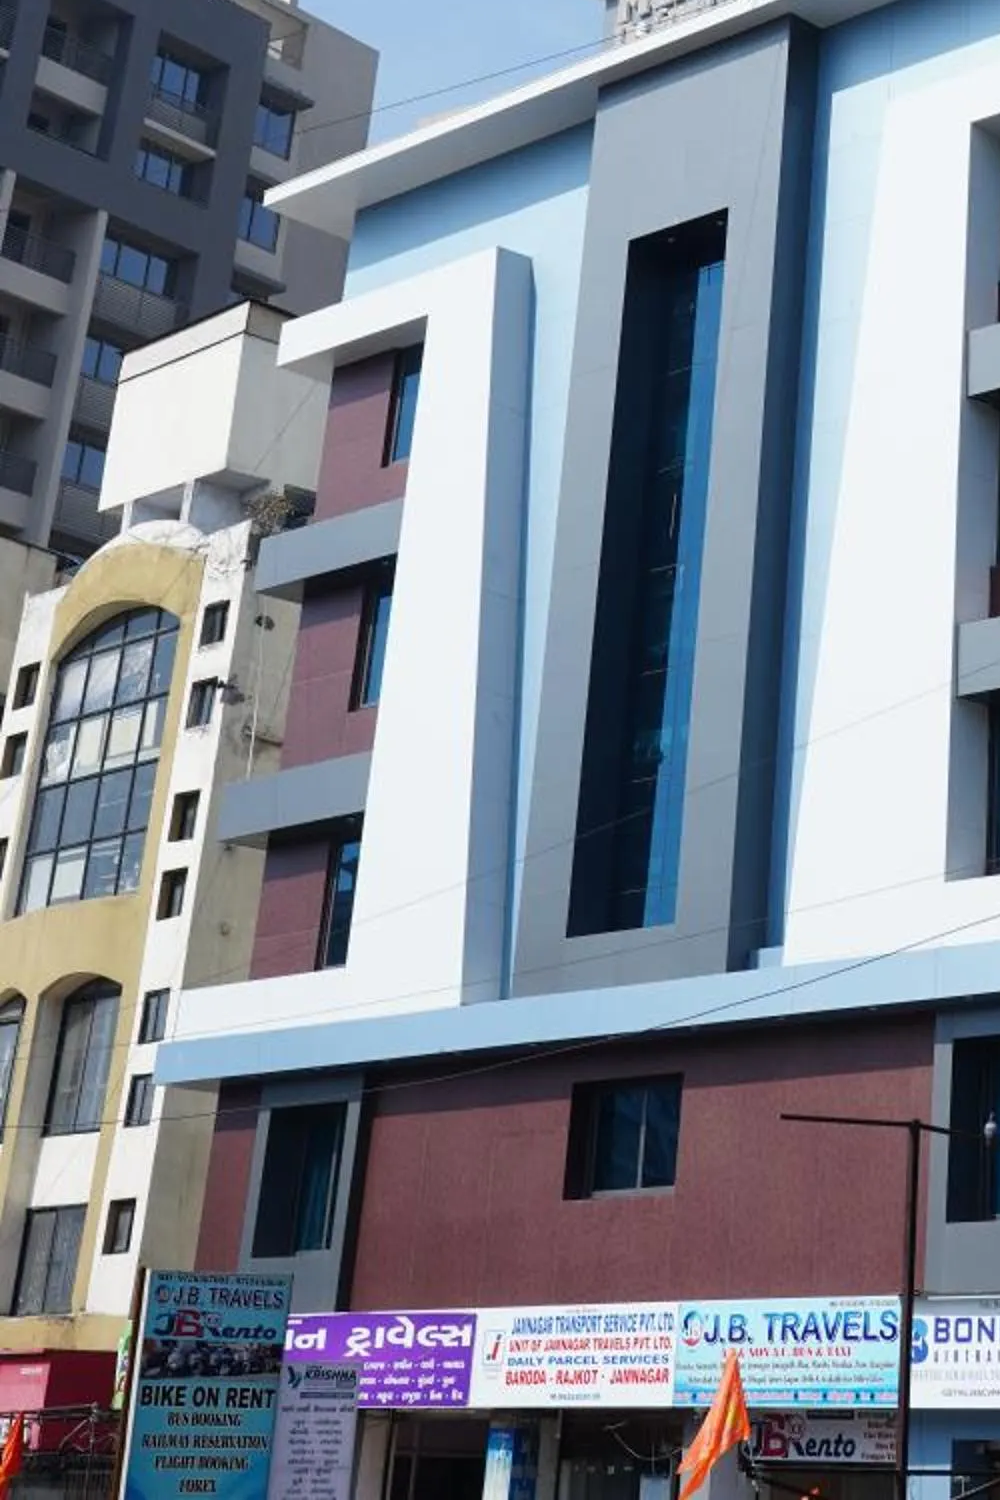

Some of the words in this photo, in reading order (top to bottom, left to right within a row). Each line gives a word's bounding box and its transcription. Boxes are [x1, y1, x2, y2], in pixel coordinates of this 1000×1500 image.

[209, 1287, 285, 1310] TRAVELS
[511, 1314, 553, 1335] JAMNAGAR
[555, 1313, 602, 1334] TRANSPORT
[603, 1312, 637, 1333] SERVICE
[703, 1313, 753, 1344] J.B.
[763, 1309, 899, 1343] TRAVELS
[343, 1315, 472, 1357] ટ્રાવેલ્સ
[531, 1338, 542, 1352] OF
[543, 1337, 590, 1353] JAMNAGAR
[592, 1336, 631, 1352] TRAVELS
[507, 1356, 544, 1367] DAILY
[548, 1355, 599, 1366] PARCEL
[603, 1354, 670, 1365] SERVICES
[305, 1369, 357, 1380] KRISHNA
[505, 1370, 547, 1386] BARODA
[555, 1369, 599, 1385] RAJKOT
[609, 1368, 670, 1385] JAMNAGAR
[140, 1385, 187, 1407] BIKE
[193, 1386, 219, 1408] ON
[225, 1387, 277, 1409] RENT
[167, 1412, 190, 1426] BUS
[191, 1413, 242, 1427] BOOKING
[142, 1433, 190, 1449] RAILWAY
[193, 1435, 270, 1450] RESERVATION
[155, 1454, 196, 1469] FLIGHT
[198, 1455, 248, 1471] BOOKING
[178, 1477, 217, 1493] FOREX
